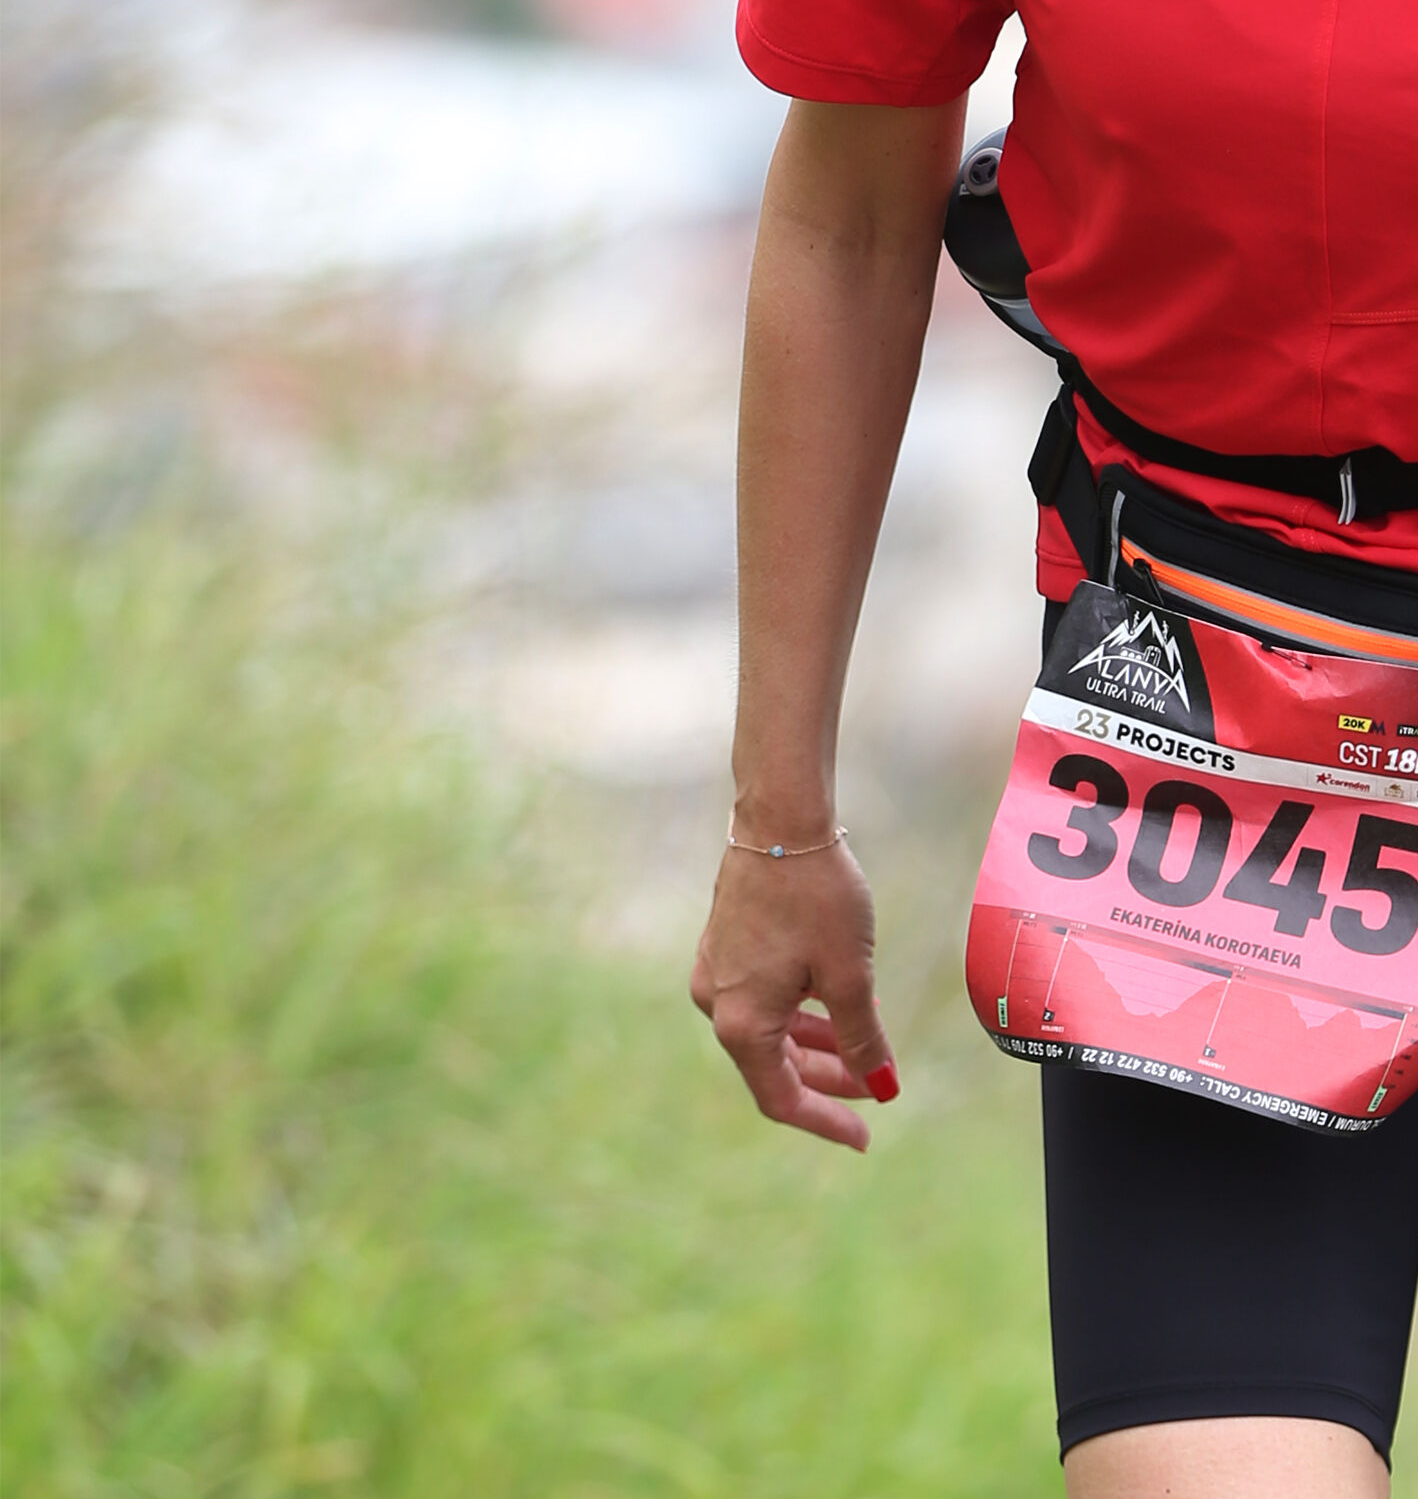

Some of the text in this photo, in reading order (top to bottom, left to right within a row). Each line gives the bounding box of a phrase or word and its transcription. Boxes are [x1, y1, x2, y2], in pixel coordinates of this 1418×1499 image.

[1067, 643, 1190, 714] ALANYA
[1086, 676, 1166, 714] ULTRA TRAIL
[1343, 717, 1367, 731] 20K
[1075, 708, 1236, 772] 23 PROJECTS
[1339, 741, 1383, 768] CST
[1110, 907, 1301, 969] EKATERİNA KOROTAEVA
[1028, 1041, 1044, 1056] 532
[1046, 1044, 1064, 1058] +90
[1081, 1047, 1099, 1063] 22
[1099, 1051, 1115, 1065] 12
[1117, 1054, 1142, 1071] 472
[1143, 1060, 1168, 1077] 532
[1169, 1068, 1193, 1083] +90
[1200, 1076, 1240, 1099] CALL:
[1241, 1090, 1329, 1126] EMERGENCY
